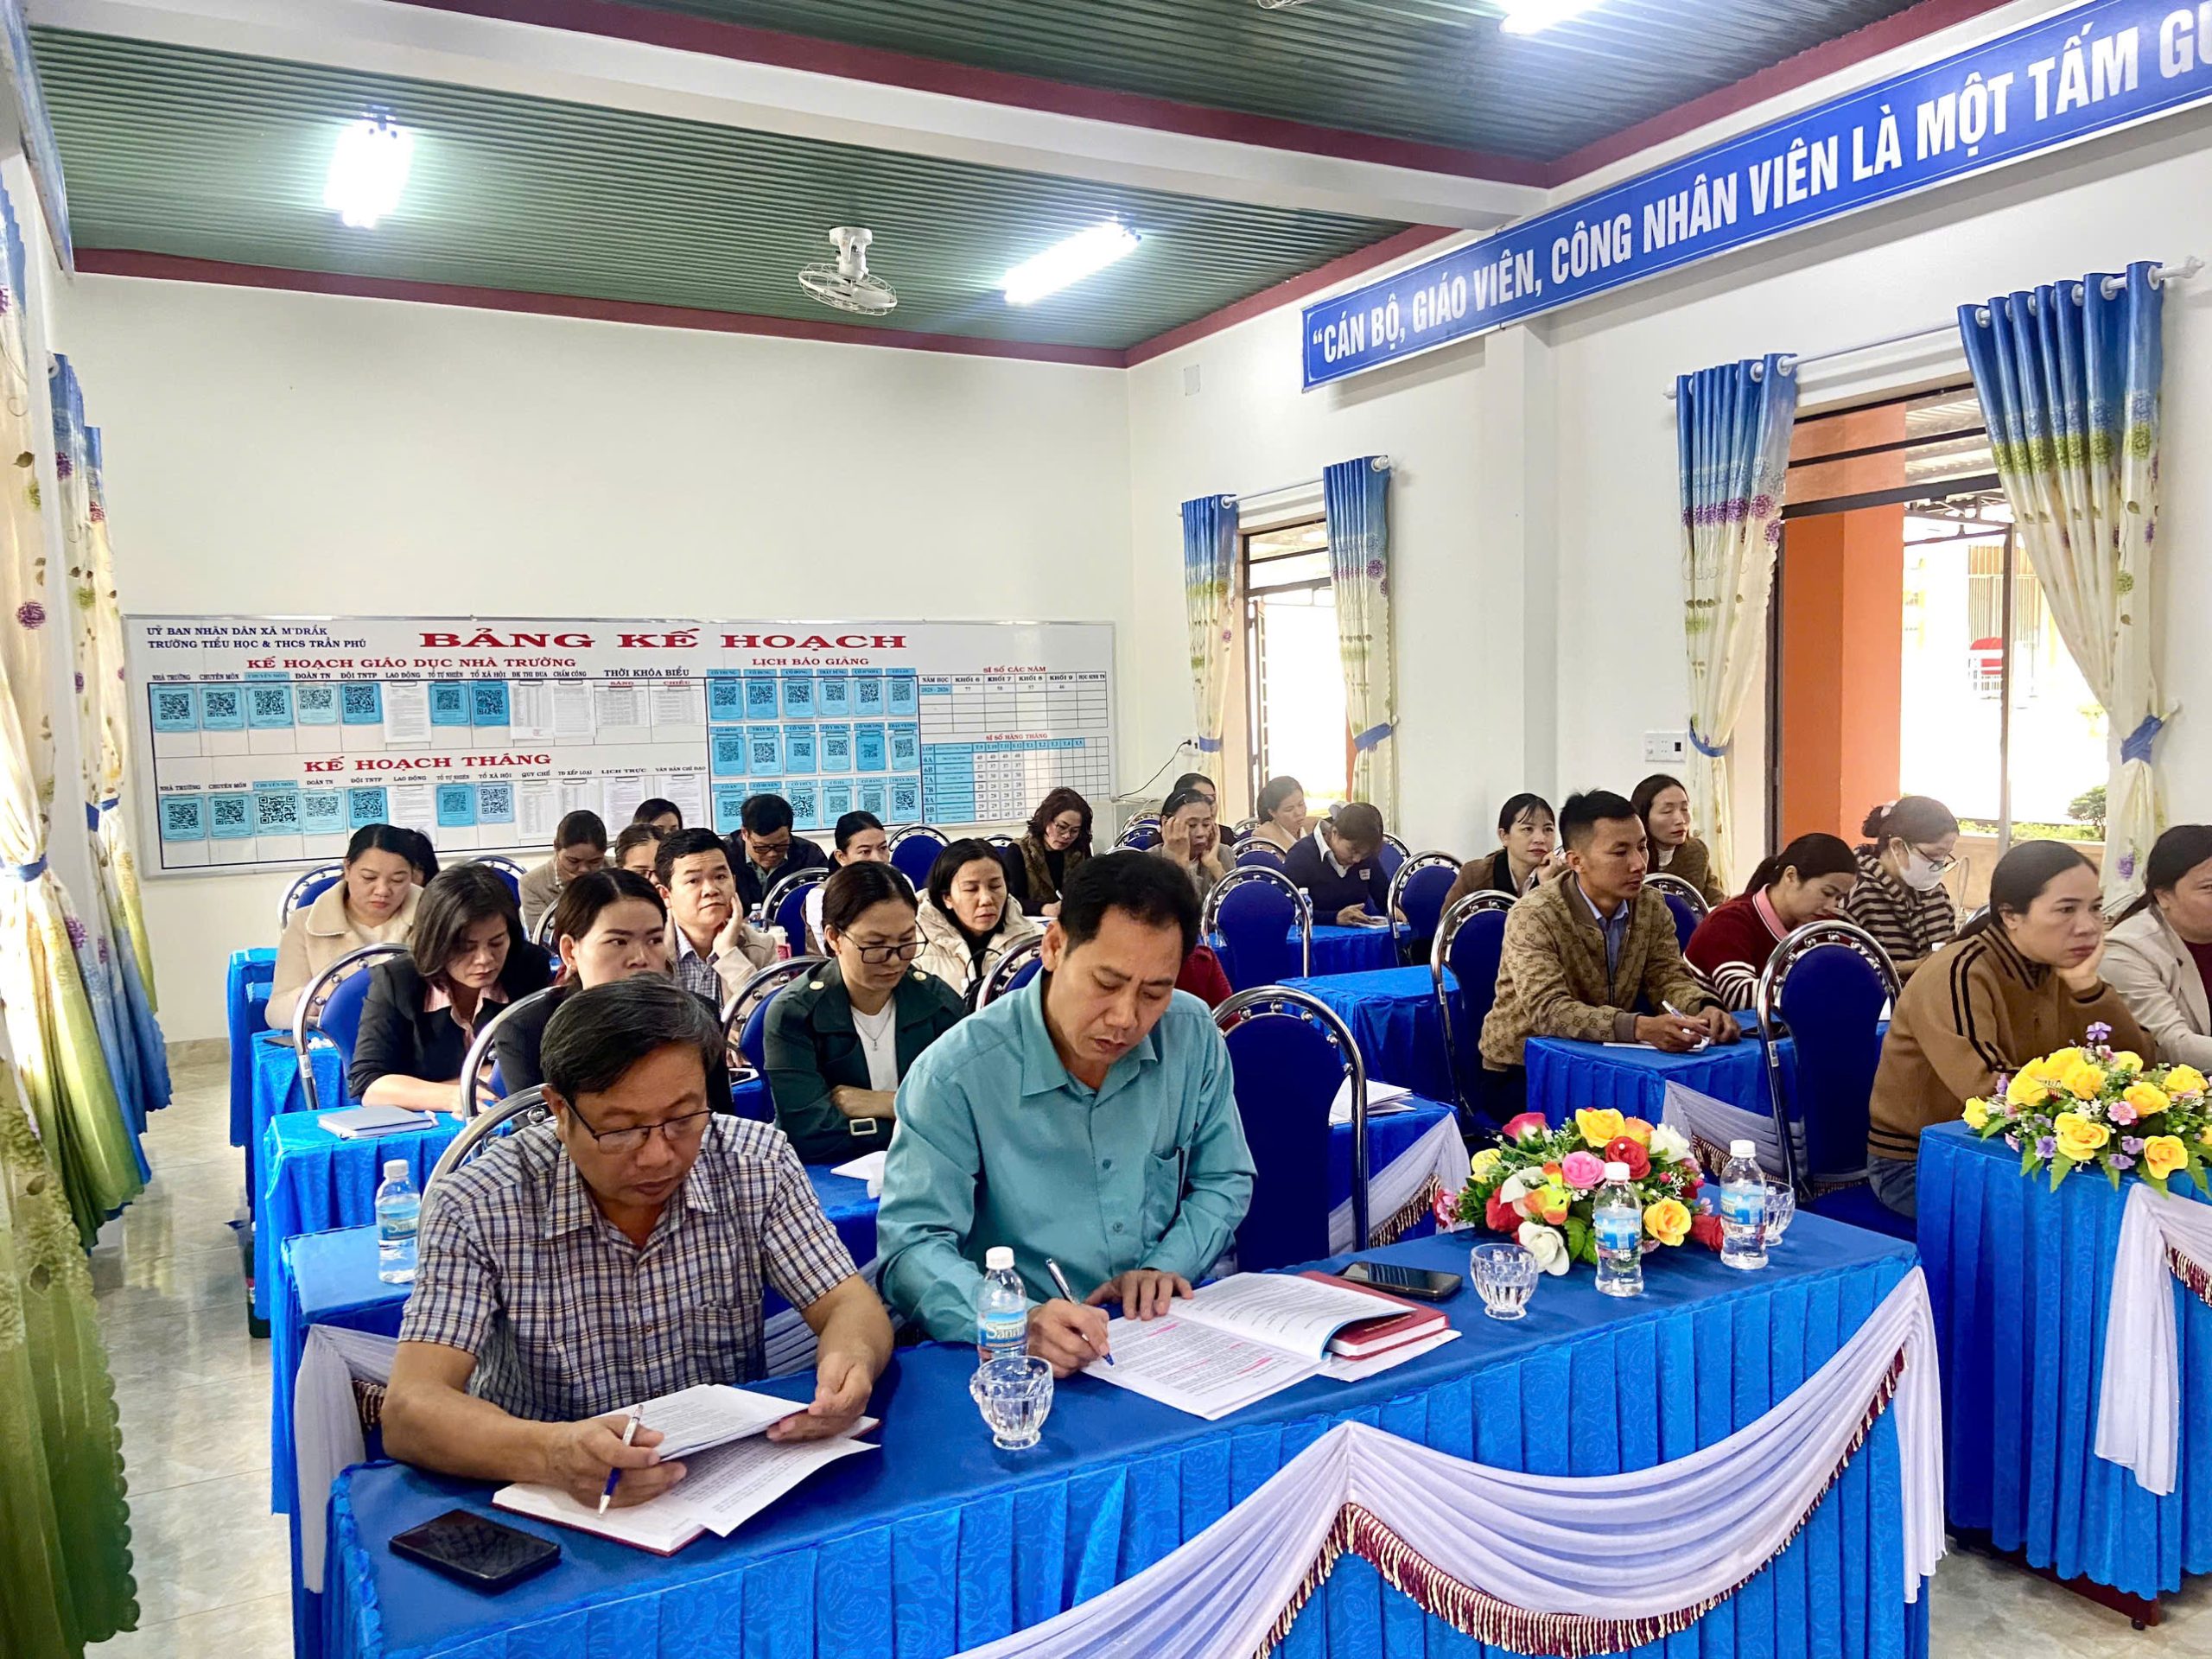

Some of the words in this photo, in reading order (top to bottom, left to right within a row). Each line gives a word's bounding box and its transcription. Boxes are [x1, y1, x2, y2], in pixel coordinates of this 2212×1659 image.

[1370, 294, 1406, 350] BỘ,
[1413, 271, 1466, 334] GIÁO
[1473, 249, 1542, 312] VIÊN,
[1551, 219, 1632, 286] CÔNG
[1643, 178, 1738, 252] NHÂN
[1748, 137, 1839, 217] VIÊN
[1852, 105, 1903, 182] LÀ
[1916, 72, 2014, 162] MỘT
[2028, 21, 2139, 123] TẤM
[166, 627, 191, 636] BAN
[194, 624, 228, 636] NHÂN
[232, 624, 257, 636] DÂN
[260, 625, 277, 635] XÃ
[147, 639, 198, 649] TRƯỜNG
[201, 636, 229, 649] TIỂU
[233, 639, 258, 650] HỌC
[262, 639, 271, 648] &
[275, 639, 306, 648] THCS
[309, 636, 340, 648] TRẦN
[344, 638, 366, 648] PHÚ
[418, 627, 596, 648] BẢNG
[616, 627, 701, 648] KẾ
[720, 634, 907, 652] HOẠCH
[246, 655, 276, 669] KẾ
[283, 658, 353, 671] HOẠCH
[360, 657, 407, 668] GIÁO
[413, 658, 453, 670] DỤC
[459, 656, 498, 668] NHÀ
[504, 657, 576, 667] TRƯỜNG
[752, 658, 787, 668] LỊCH
[791, 657, 821, 665] BÁO
[1007, 664, 1026, 673] CÁC
[493, 670, 506, 678] HỘI
[604, 668, 629, 677] THỜI
[632, 667, 663, 677] KHÓA
[665, 665, 690, 677] BIỂU
[304, 756, 345, 772] KẾ
[355, 758, 452, 772] HOẠCH
[461, 753, 552, 767] THÁNG
